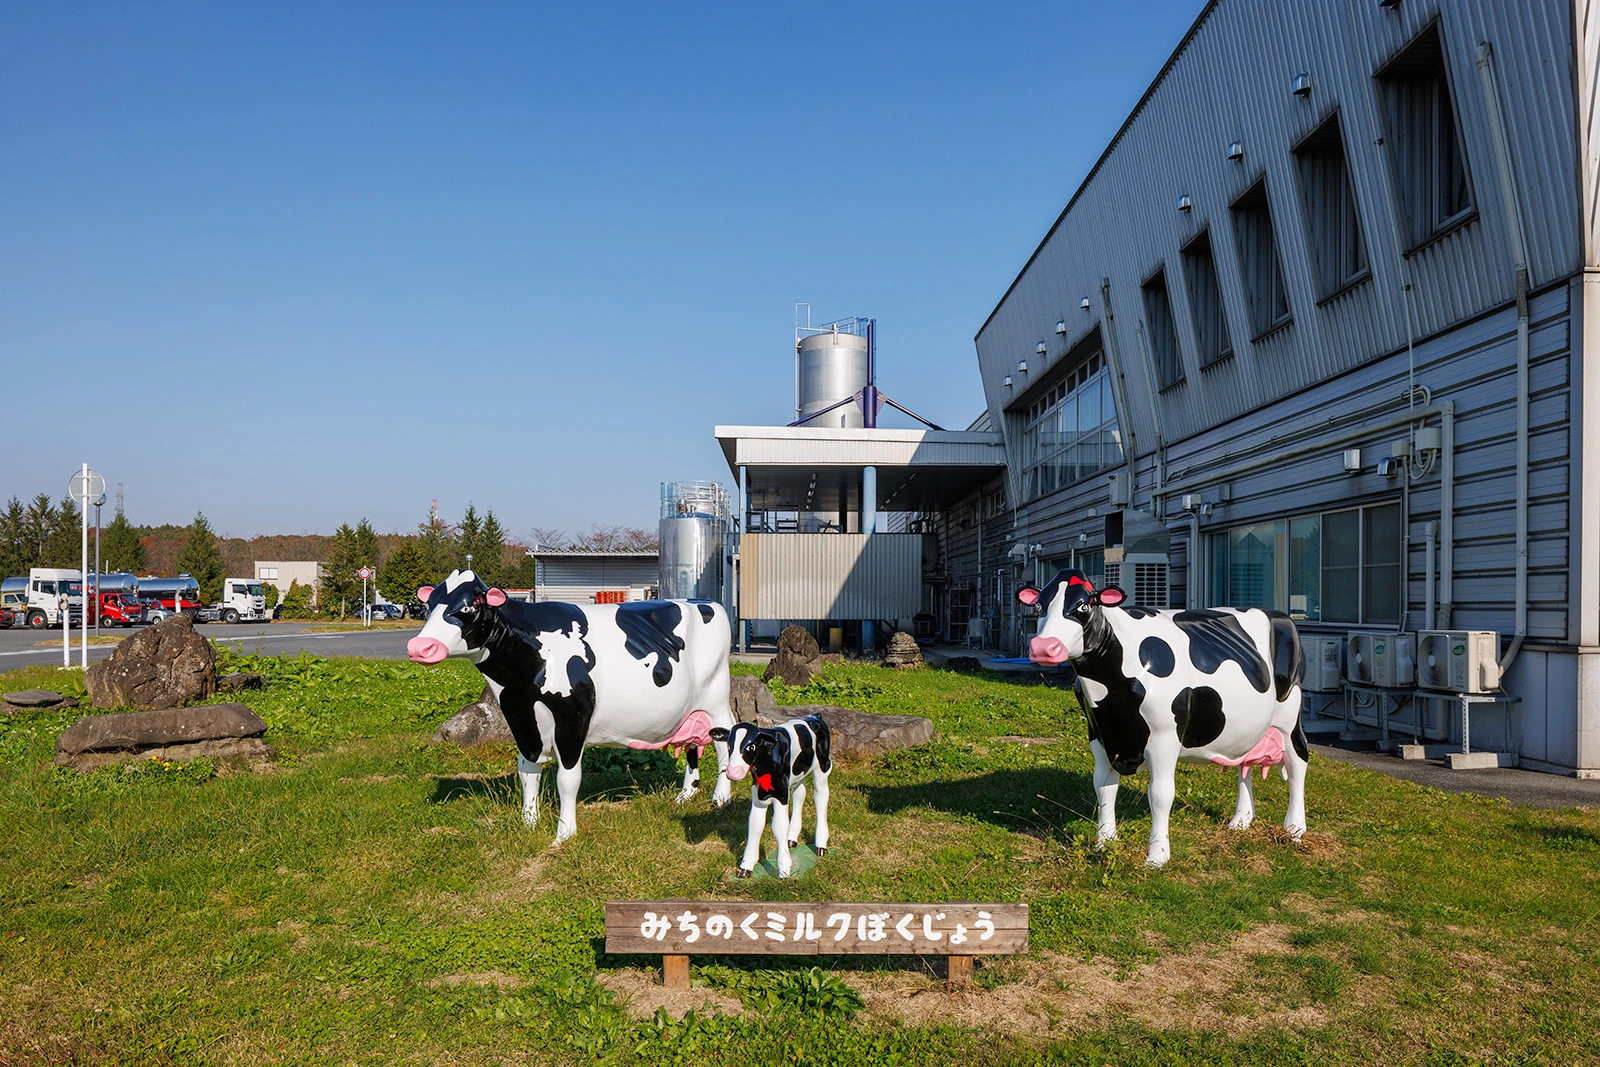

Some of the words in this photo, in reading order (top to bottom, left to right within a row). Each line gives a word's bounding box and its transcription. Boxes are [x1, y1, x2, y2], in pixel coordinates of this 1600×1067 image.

[640, 910, 995, 945] みちのくミルクぼくじょう
